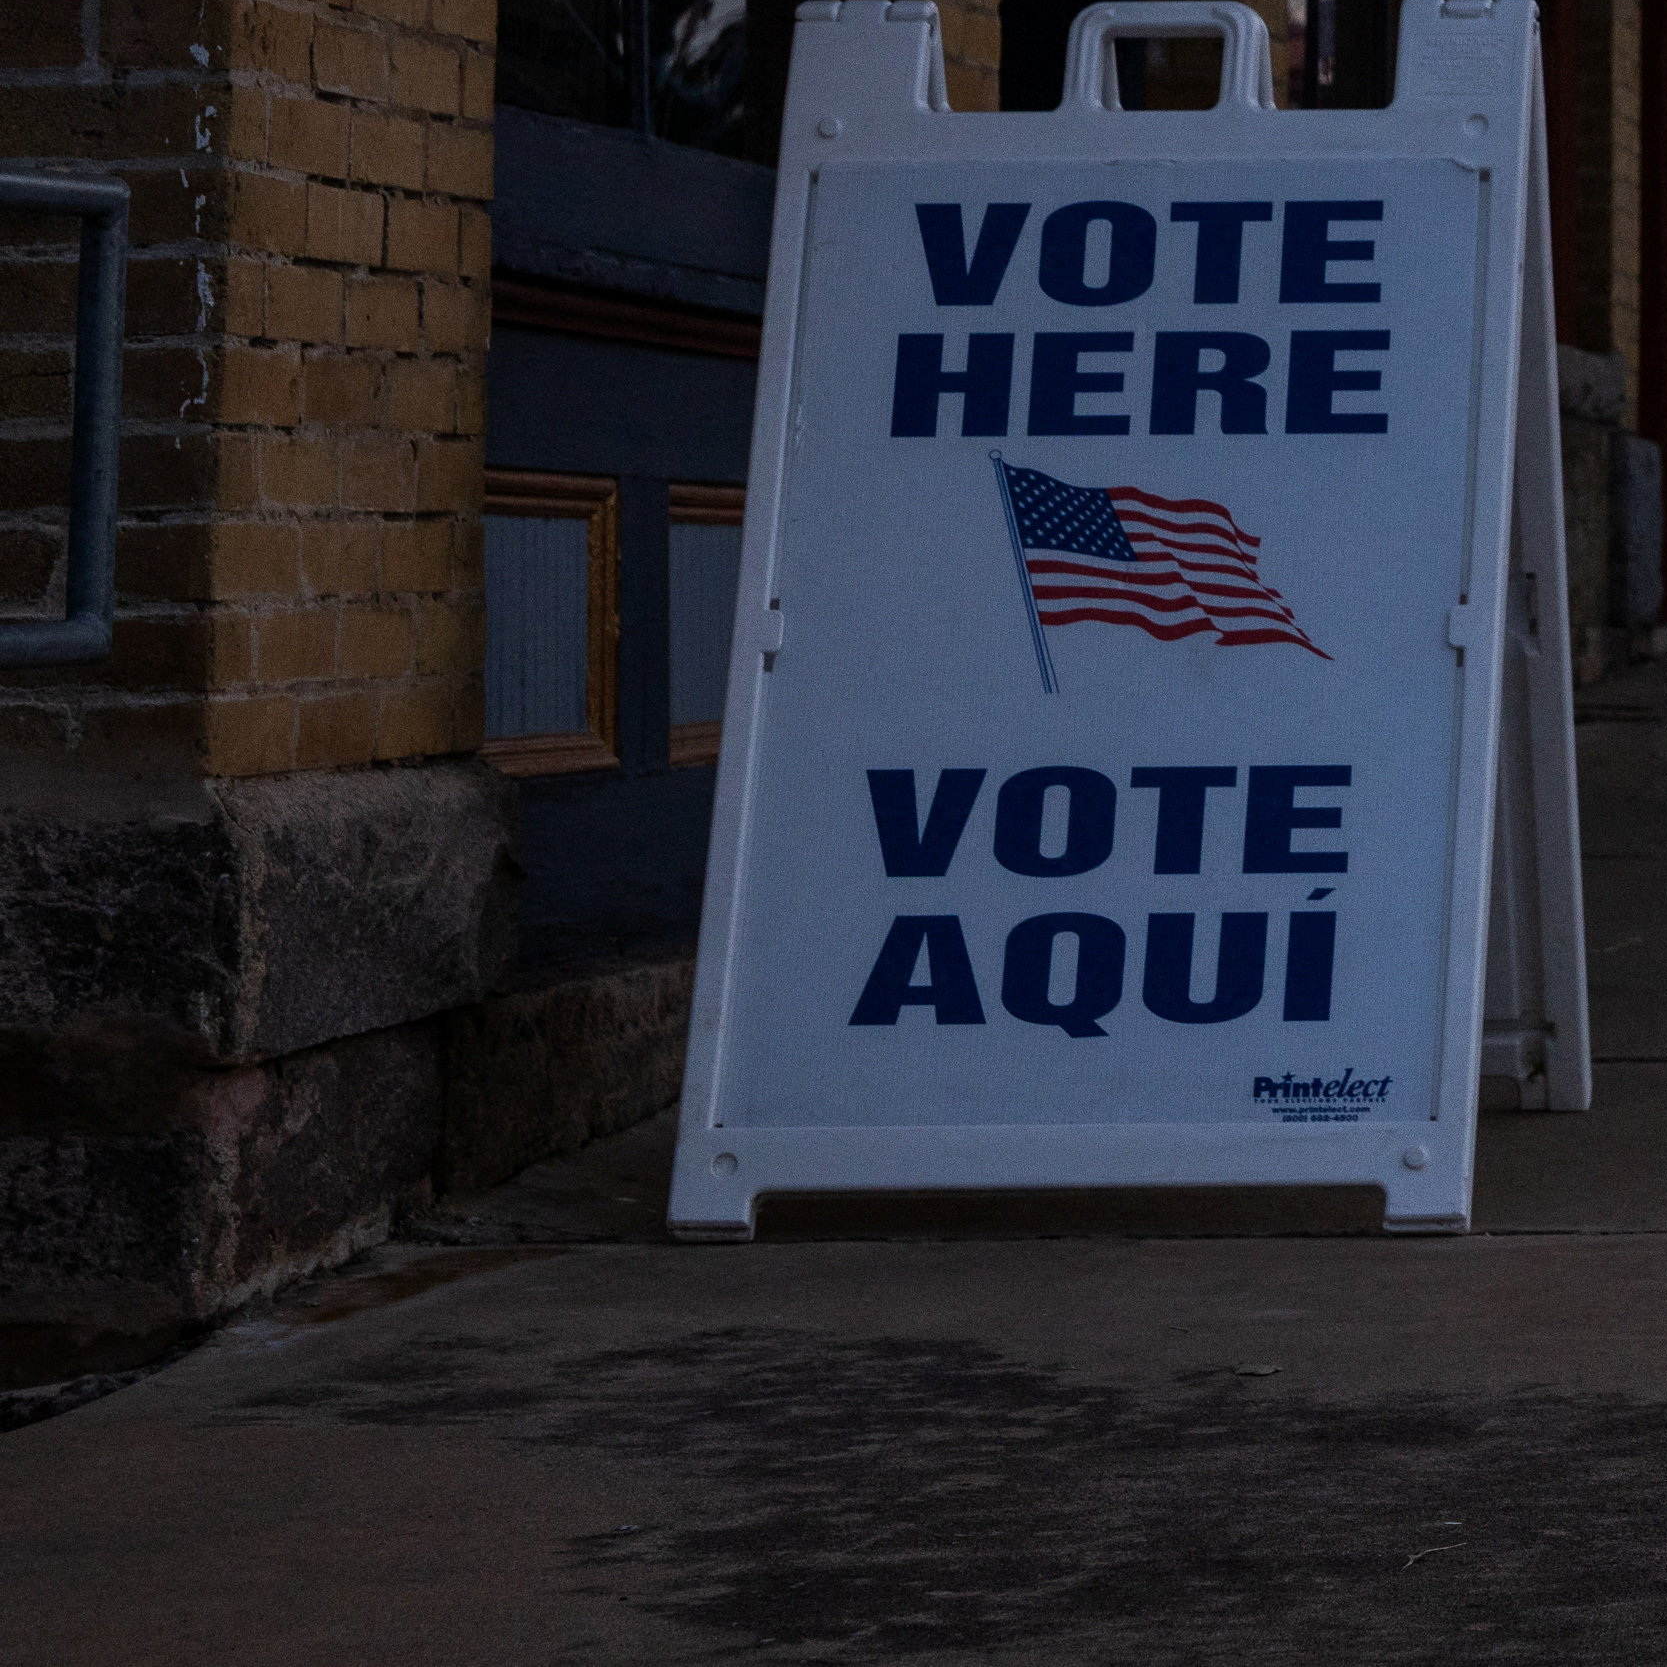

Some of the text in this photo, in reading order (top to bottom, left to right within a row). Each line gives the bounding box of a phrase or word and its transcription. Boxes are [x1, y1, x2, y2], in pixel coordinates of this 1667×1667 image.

[914, 199, 1384, 308] VOTE
[890, 329, 1391, 438] HERE
[866, 764, 1353, 879] VOTE
[848, 887, 1337, 1039] AQUÍ
[1253, 1067, 1393, 1099] Printelect
[1271, 1105, 1371, 1114] www.printelect.com
